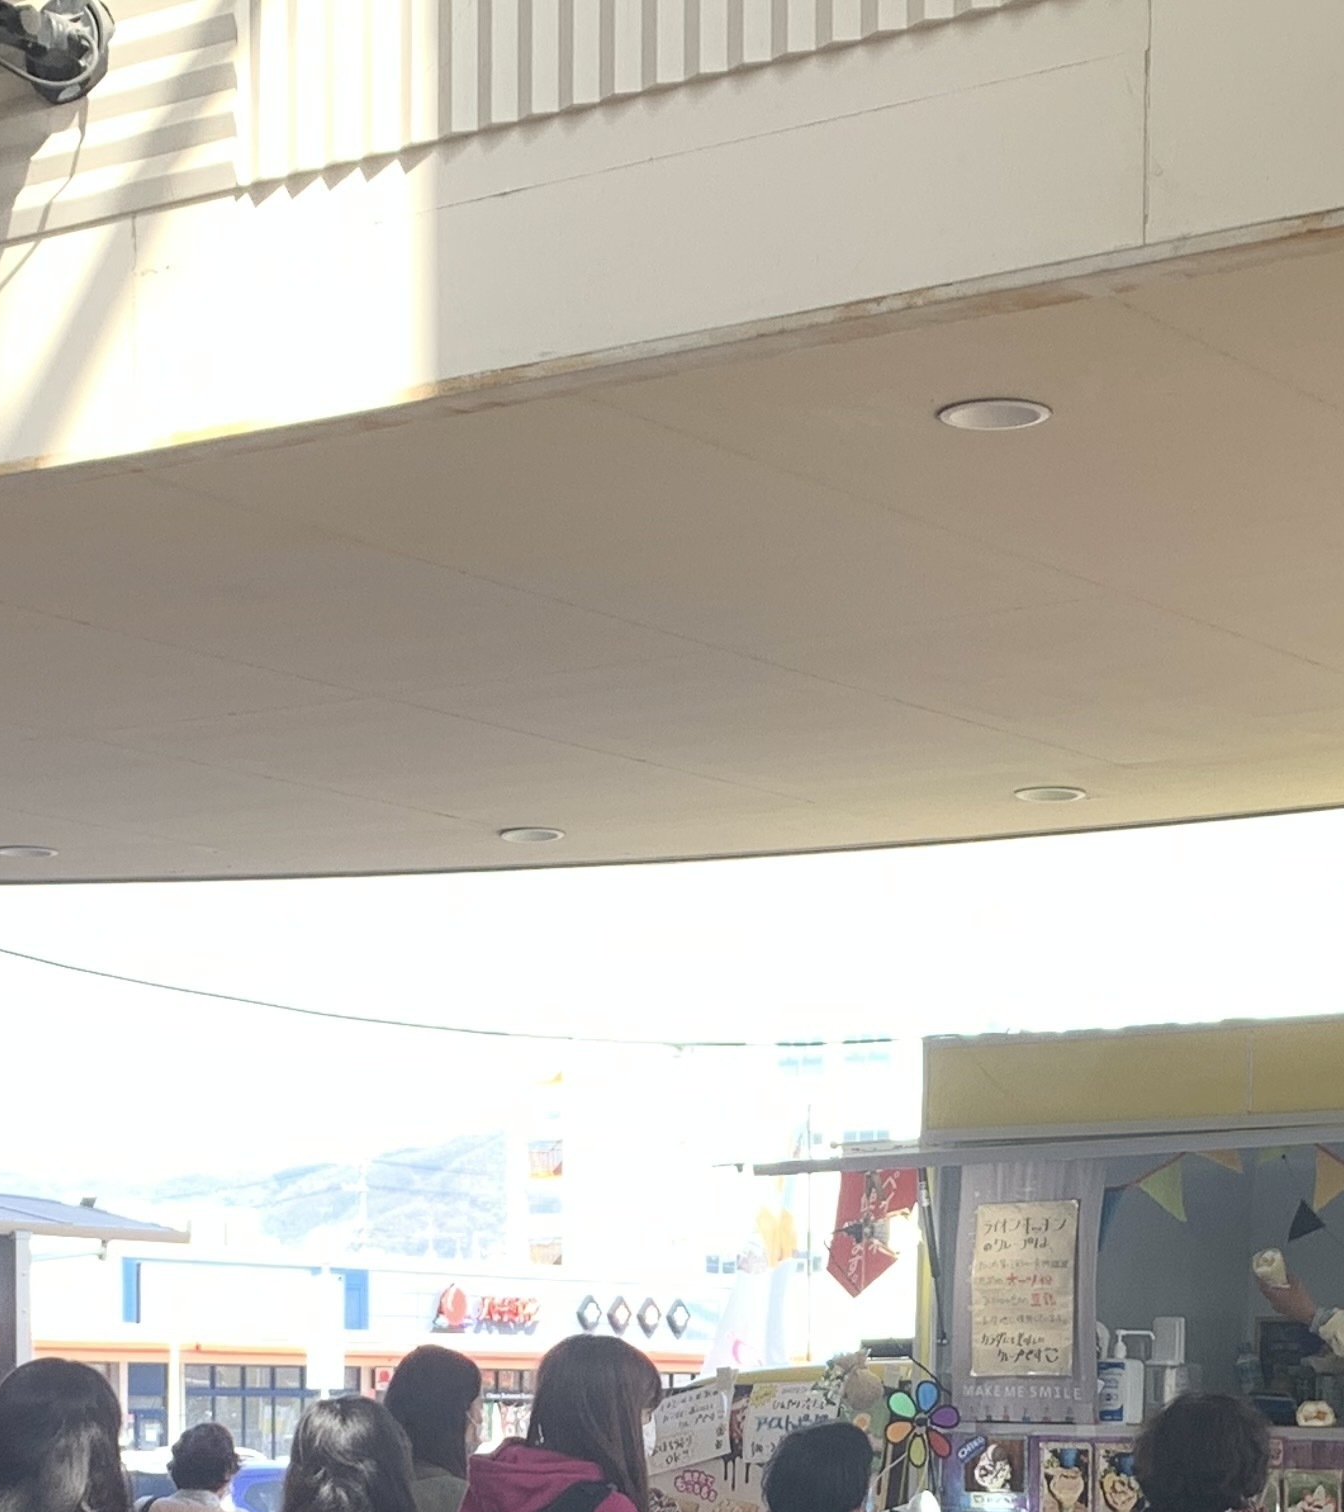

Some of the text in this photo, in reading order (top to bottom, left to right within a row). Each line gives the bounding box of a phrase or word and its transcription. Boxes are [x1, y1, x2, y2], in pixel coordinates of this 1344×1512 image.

[962, 1384, 1082, 1401] MAKE ME SMILE
